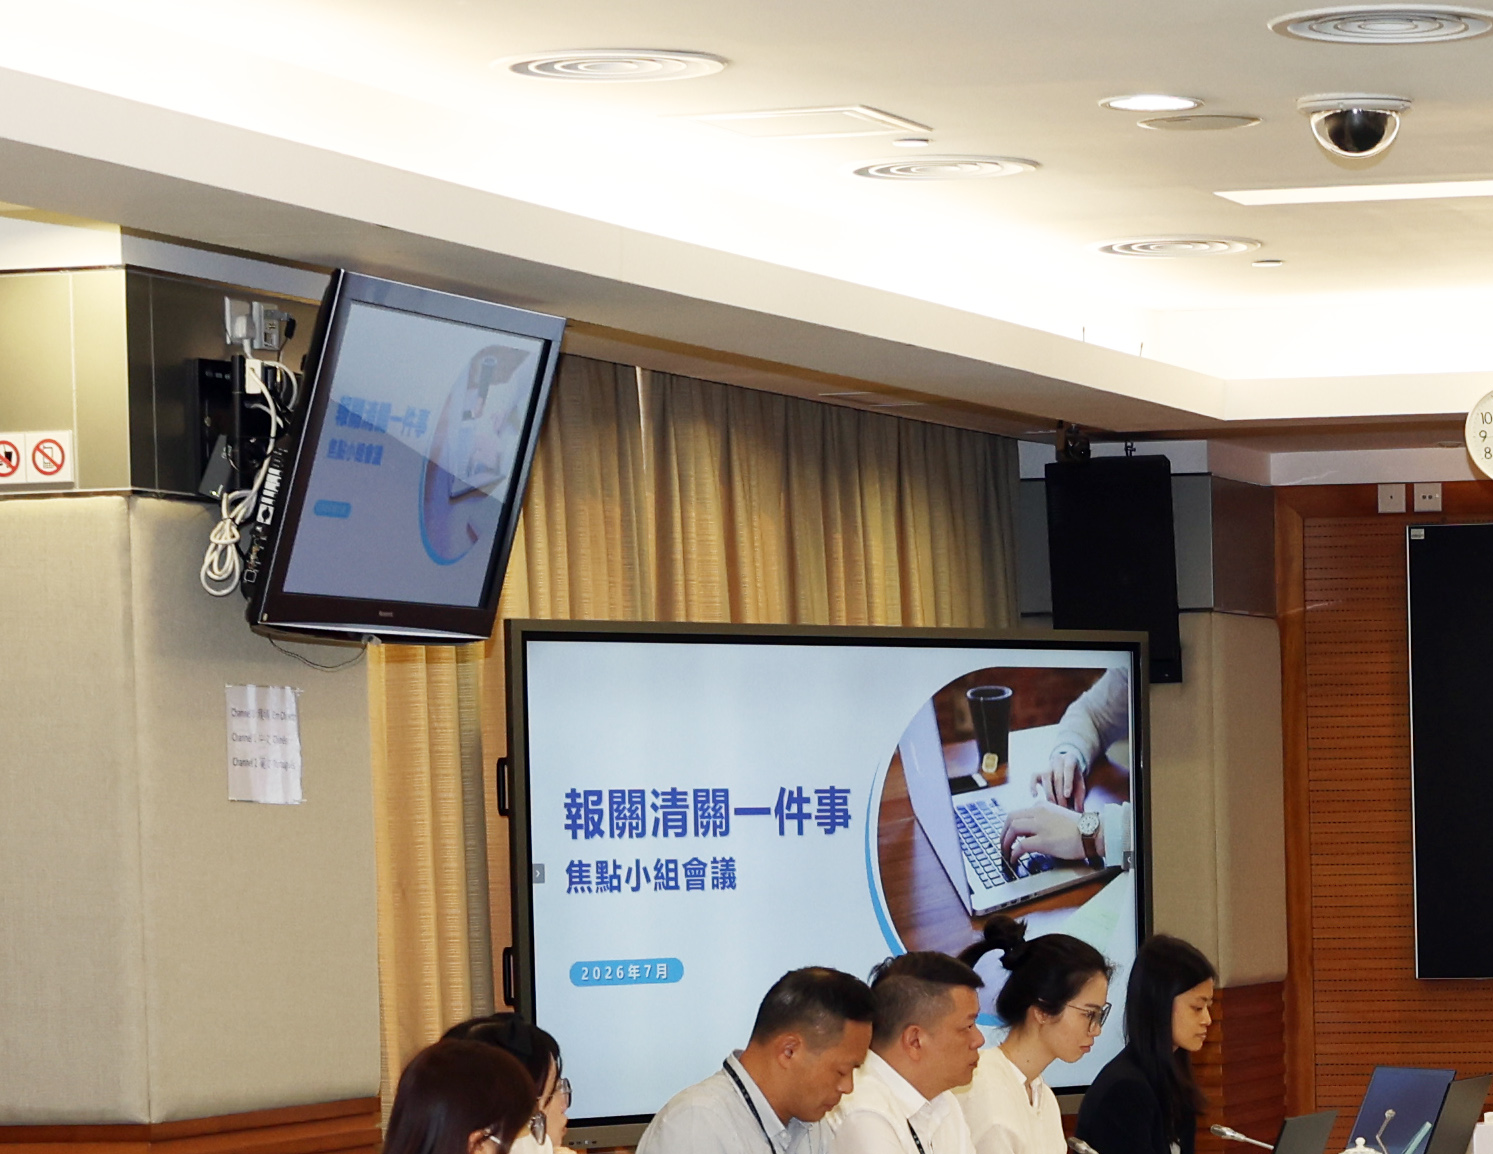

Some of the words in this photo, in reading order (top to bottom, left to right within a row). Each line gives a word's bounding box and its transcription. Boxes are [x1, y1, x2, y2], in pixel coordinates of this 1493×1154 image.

[1480, 411, 1493, 424] 10
[1479, 430, 1488, 442] 9
[1484, 447, 1493, 459] 8
[564, 786, 852, 840] 報關清關一件事
[565, 857, 737, 894] 焦點小組會議
[581, 963, 668, 981] 2026年7月
